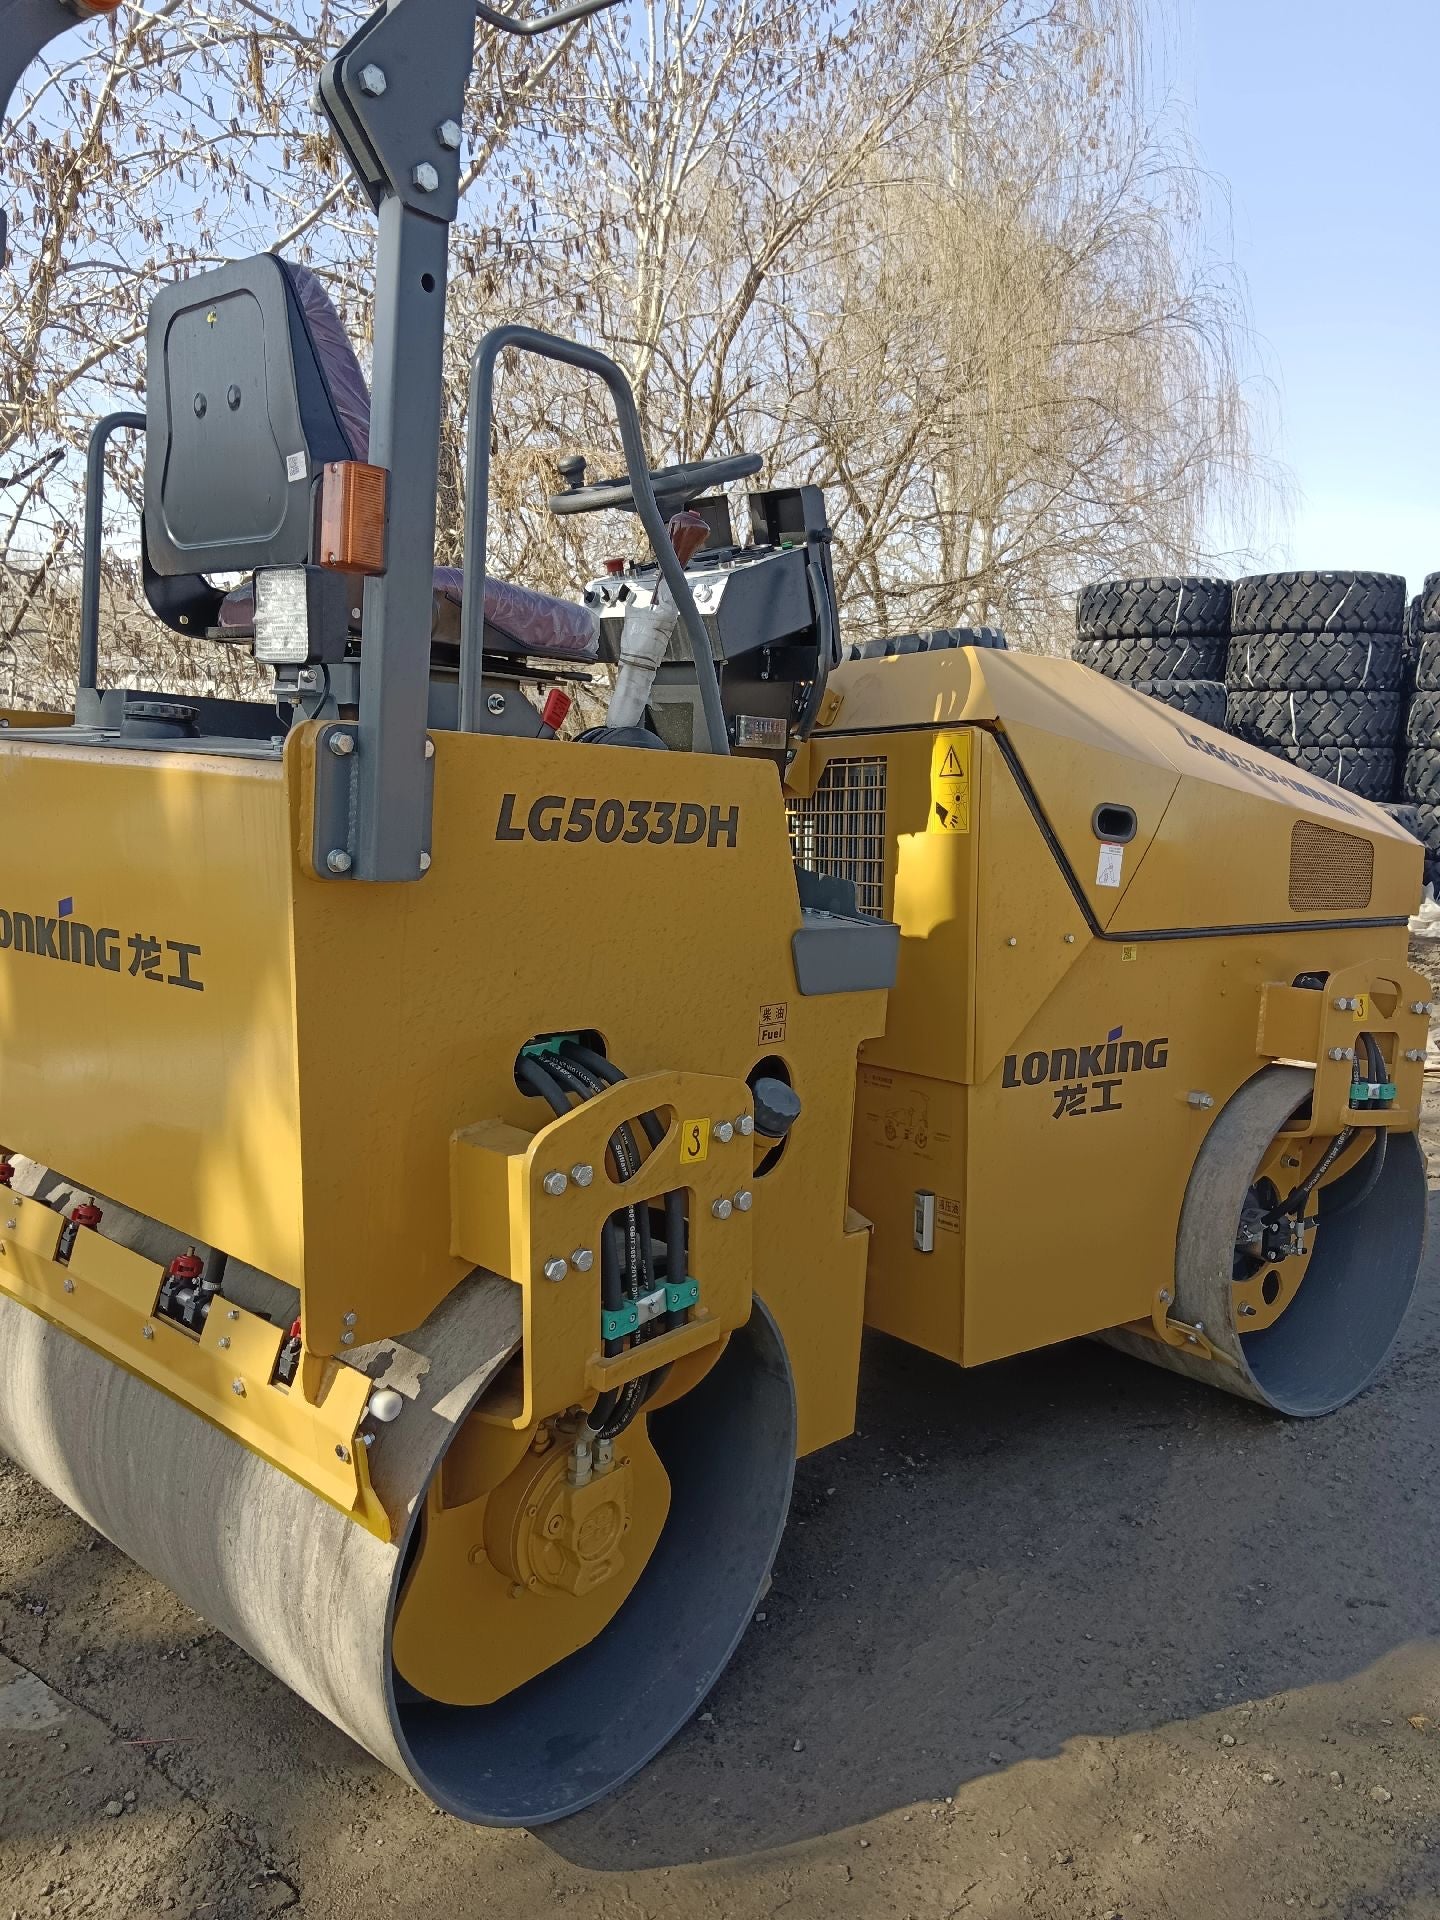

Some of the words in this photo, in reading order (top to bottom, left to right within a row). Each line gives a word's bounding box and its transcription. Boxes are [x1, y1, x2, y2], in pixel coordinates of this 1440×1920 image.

[494, 793, 739, 848] LG5033DH
[127, 932, 204, 992] 龙工
[761, 1027, 782, 1040] Fuel
[763, 1006, 785, 1021] 柴油
[1052, 1078, 1123, 1119] 龙工
